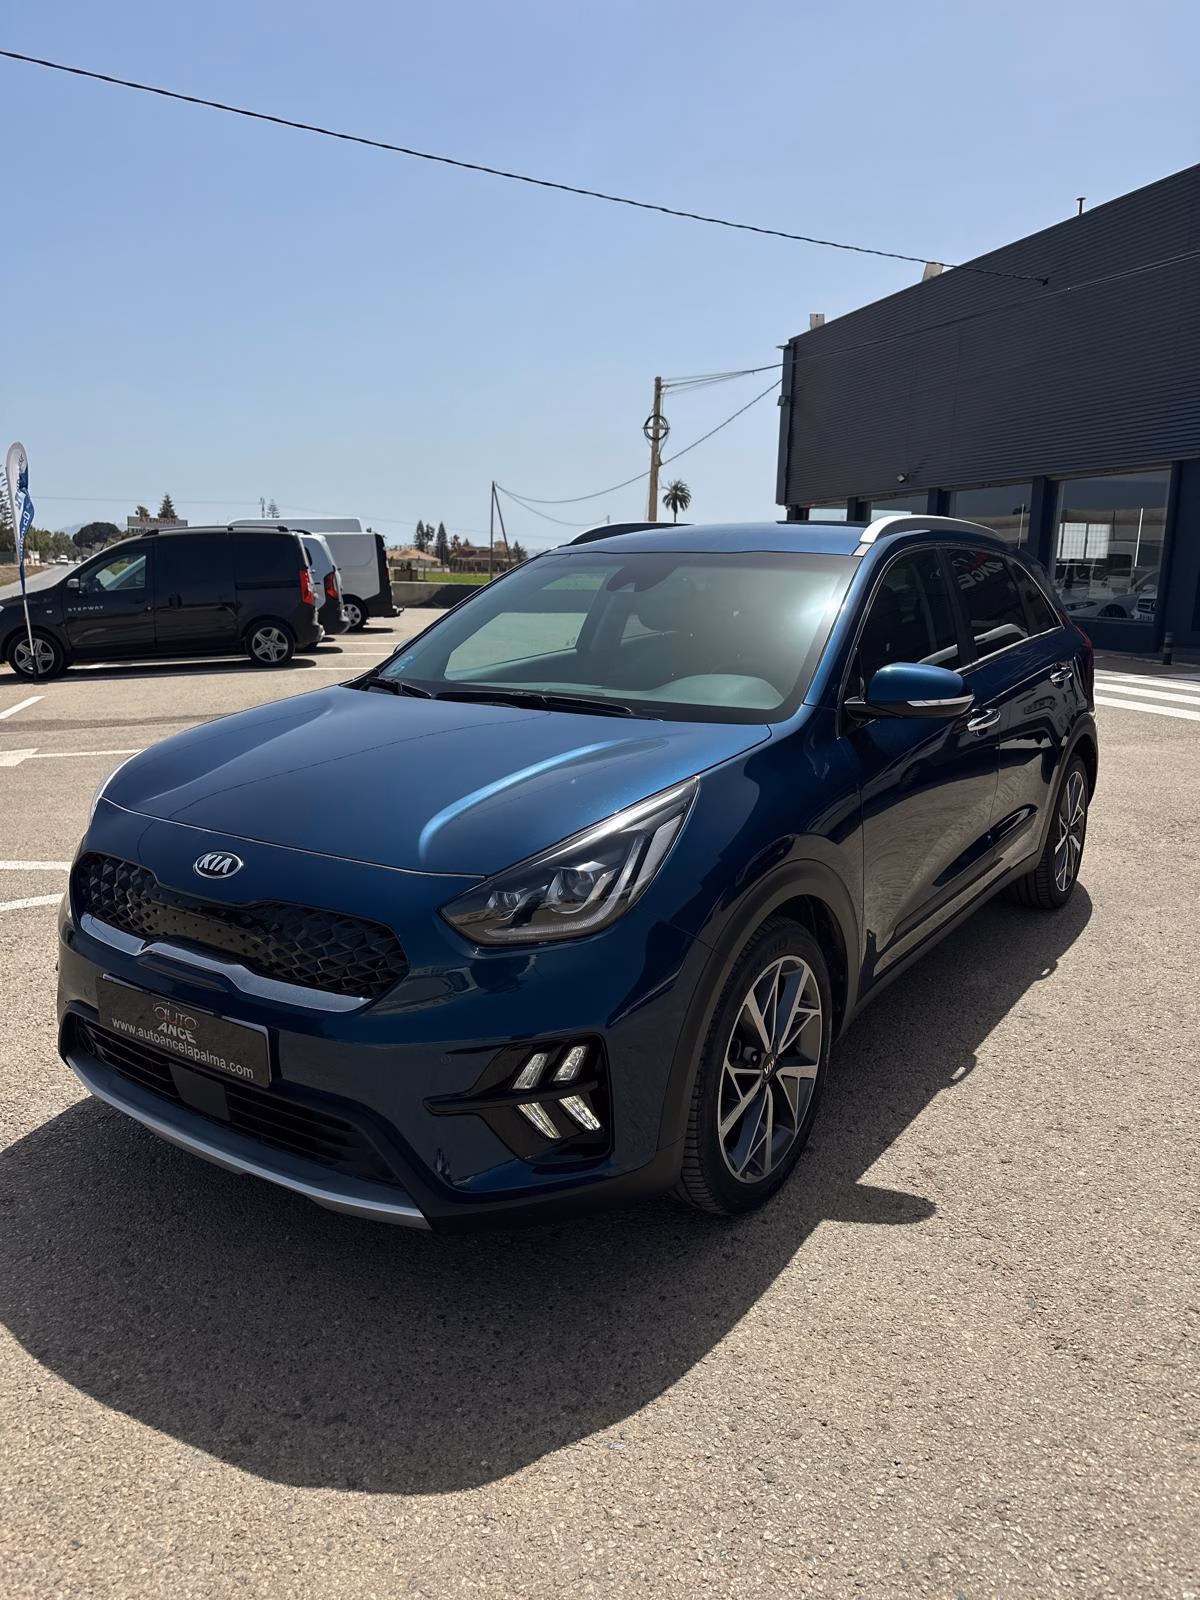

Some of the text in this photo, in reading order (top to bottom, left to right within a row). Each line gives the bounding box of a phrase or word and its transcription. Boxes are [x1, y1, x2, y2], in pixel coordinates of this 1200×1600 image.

[198, 854, 233, 874] KIA
[158, 1022, 197, 1044] ANCE
[111, 1017, 254, 1080] www.autoancelapalma.com
